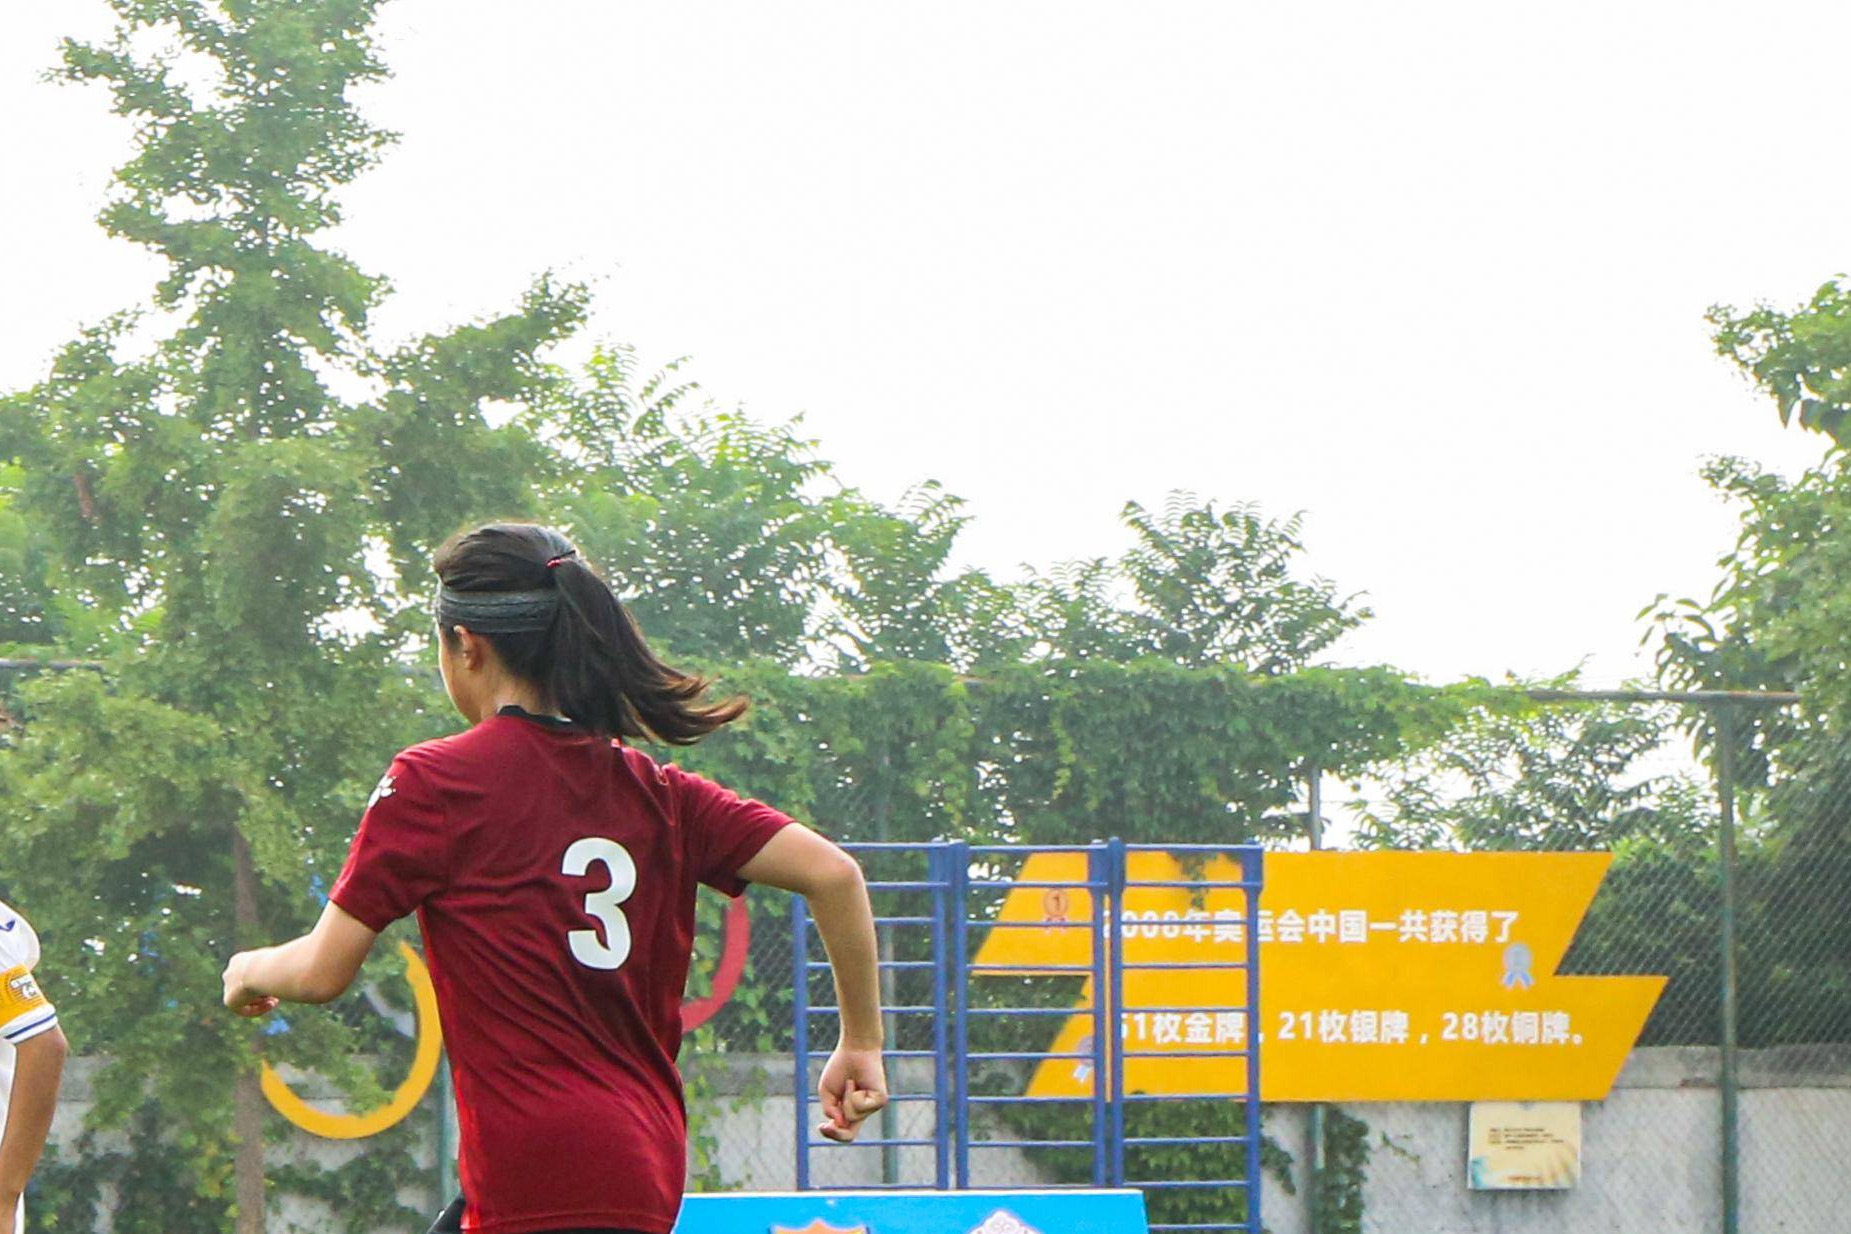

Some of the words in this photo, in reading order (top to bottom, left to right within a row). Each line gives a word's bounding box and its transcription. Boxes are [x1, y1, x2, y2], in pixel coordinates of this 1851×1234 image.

[561, 837, 637, 969] 3
[1102, 908, 1518, 943] 008年奥运会中国一共获得了
